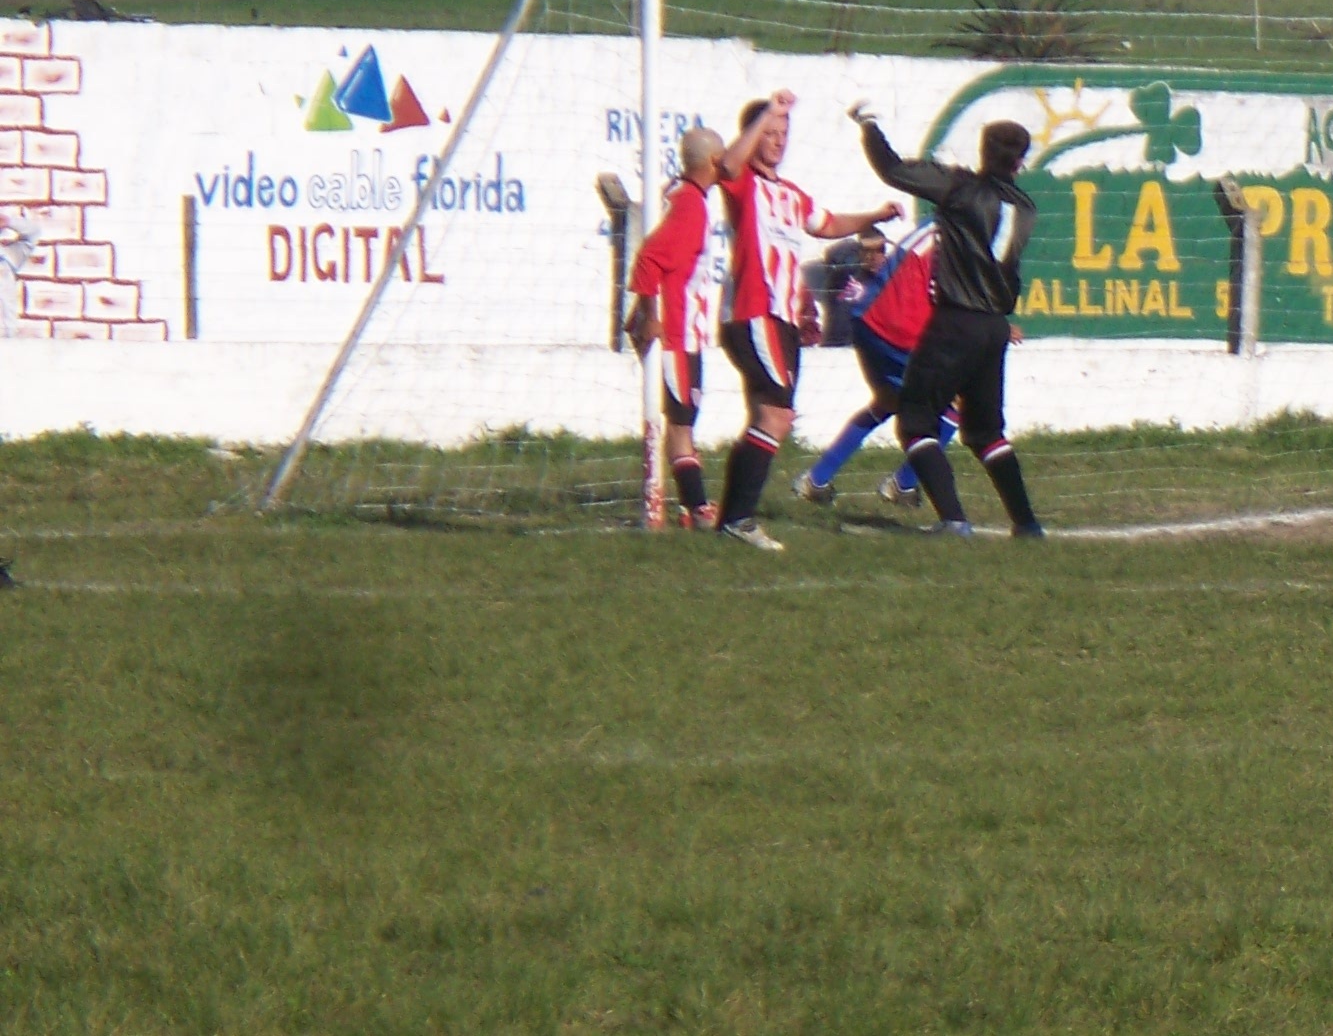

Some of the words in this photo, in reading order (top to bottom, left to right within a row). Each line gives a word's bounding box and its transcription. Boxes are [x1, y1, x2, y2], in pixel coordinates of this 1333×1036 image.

[195, 150, 298, 208] video
[306, 148, 404, 212] cable
[411, 151, 526, 213] florida
[266, 222, 446, 284] DIGITAL
[1071, 180, 1181, 272] LA
[1015, 277, 1194, 320] ALLINAL
